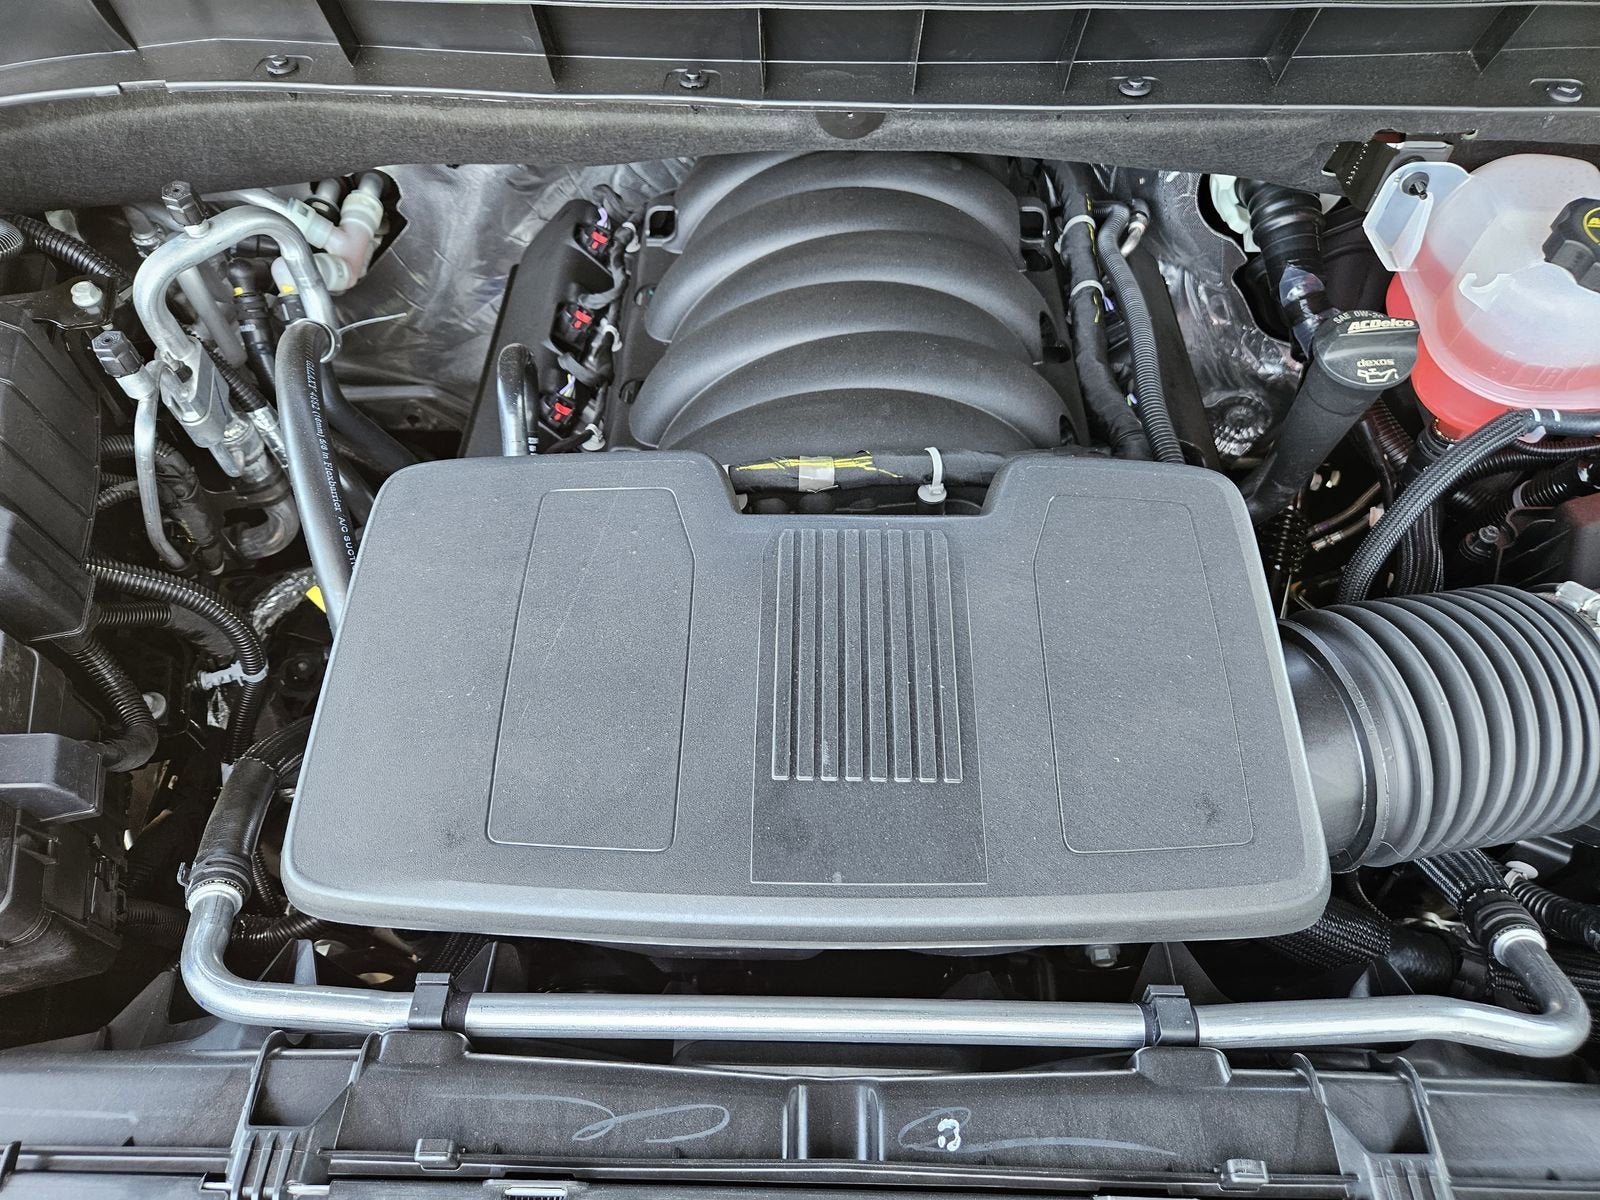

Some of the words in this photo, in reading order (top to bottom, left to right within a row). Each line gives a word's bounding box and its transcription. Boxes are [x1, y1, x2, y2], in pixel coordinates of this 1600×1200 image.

[1333, 313, 1352, 324] SAE
[1347, 318, 1415, 332] ACDelco
[1356, 358, 1395, 368] dexos
[323, 461, 343, 512] Flexbarrier
[338, 516, 349, 533] A/C
